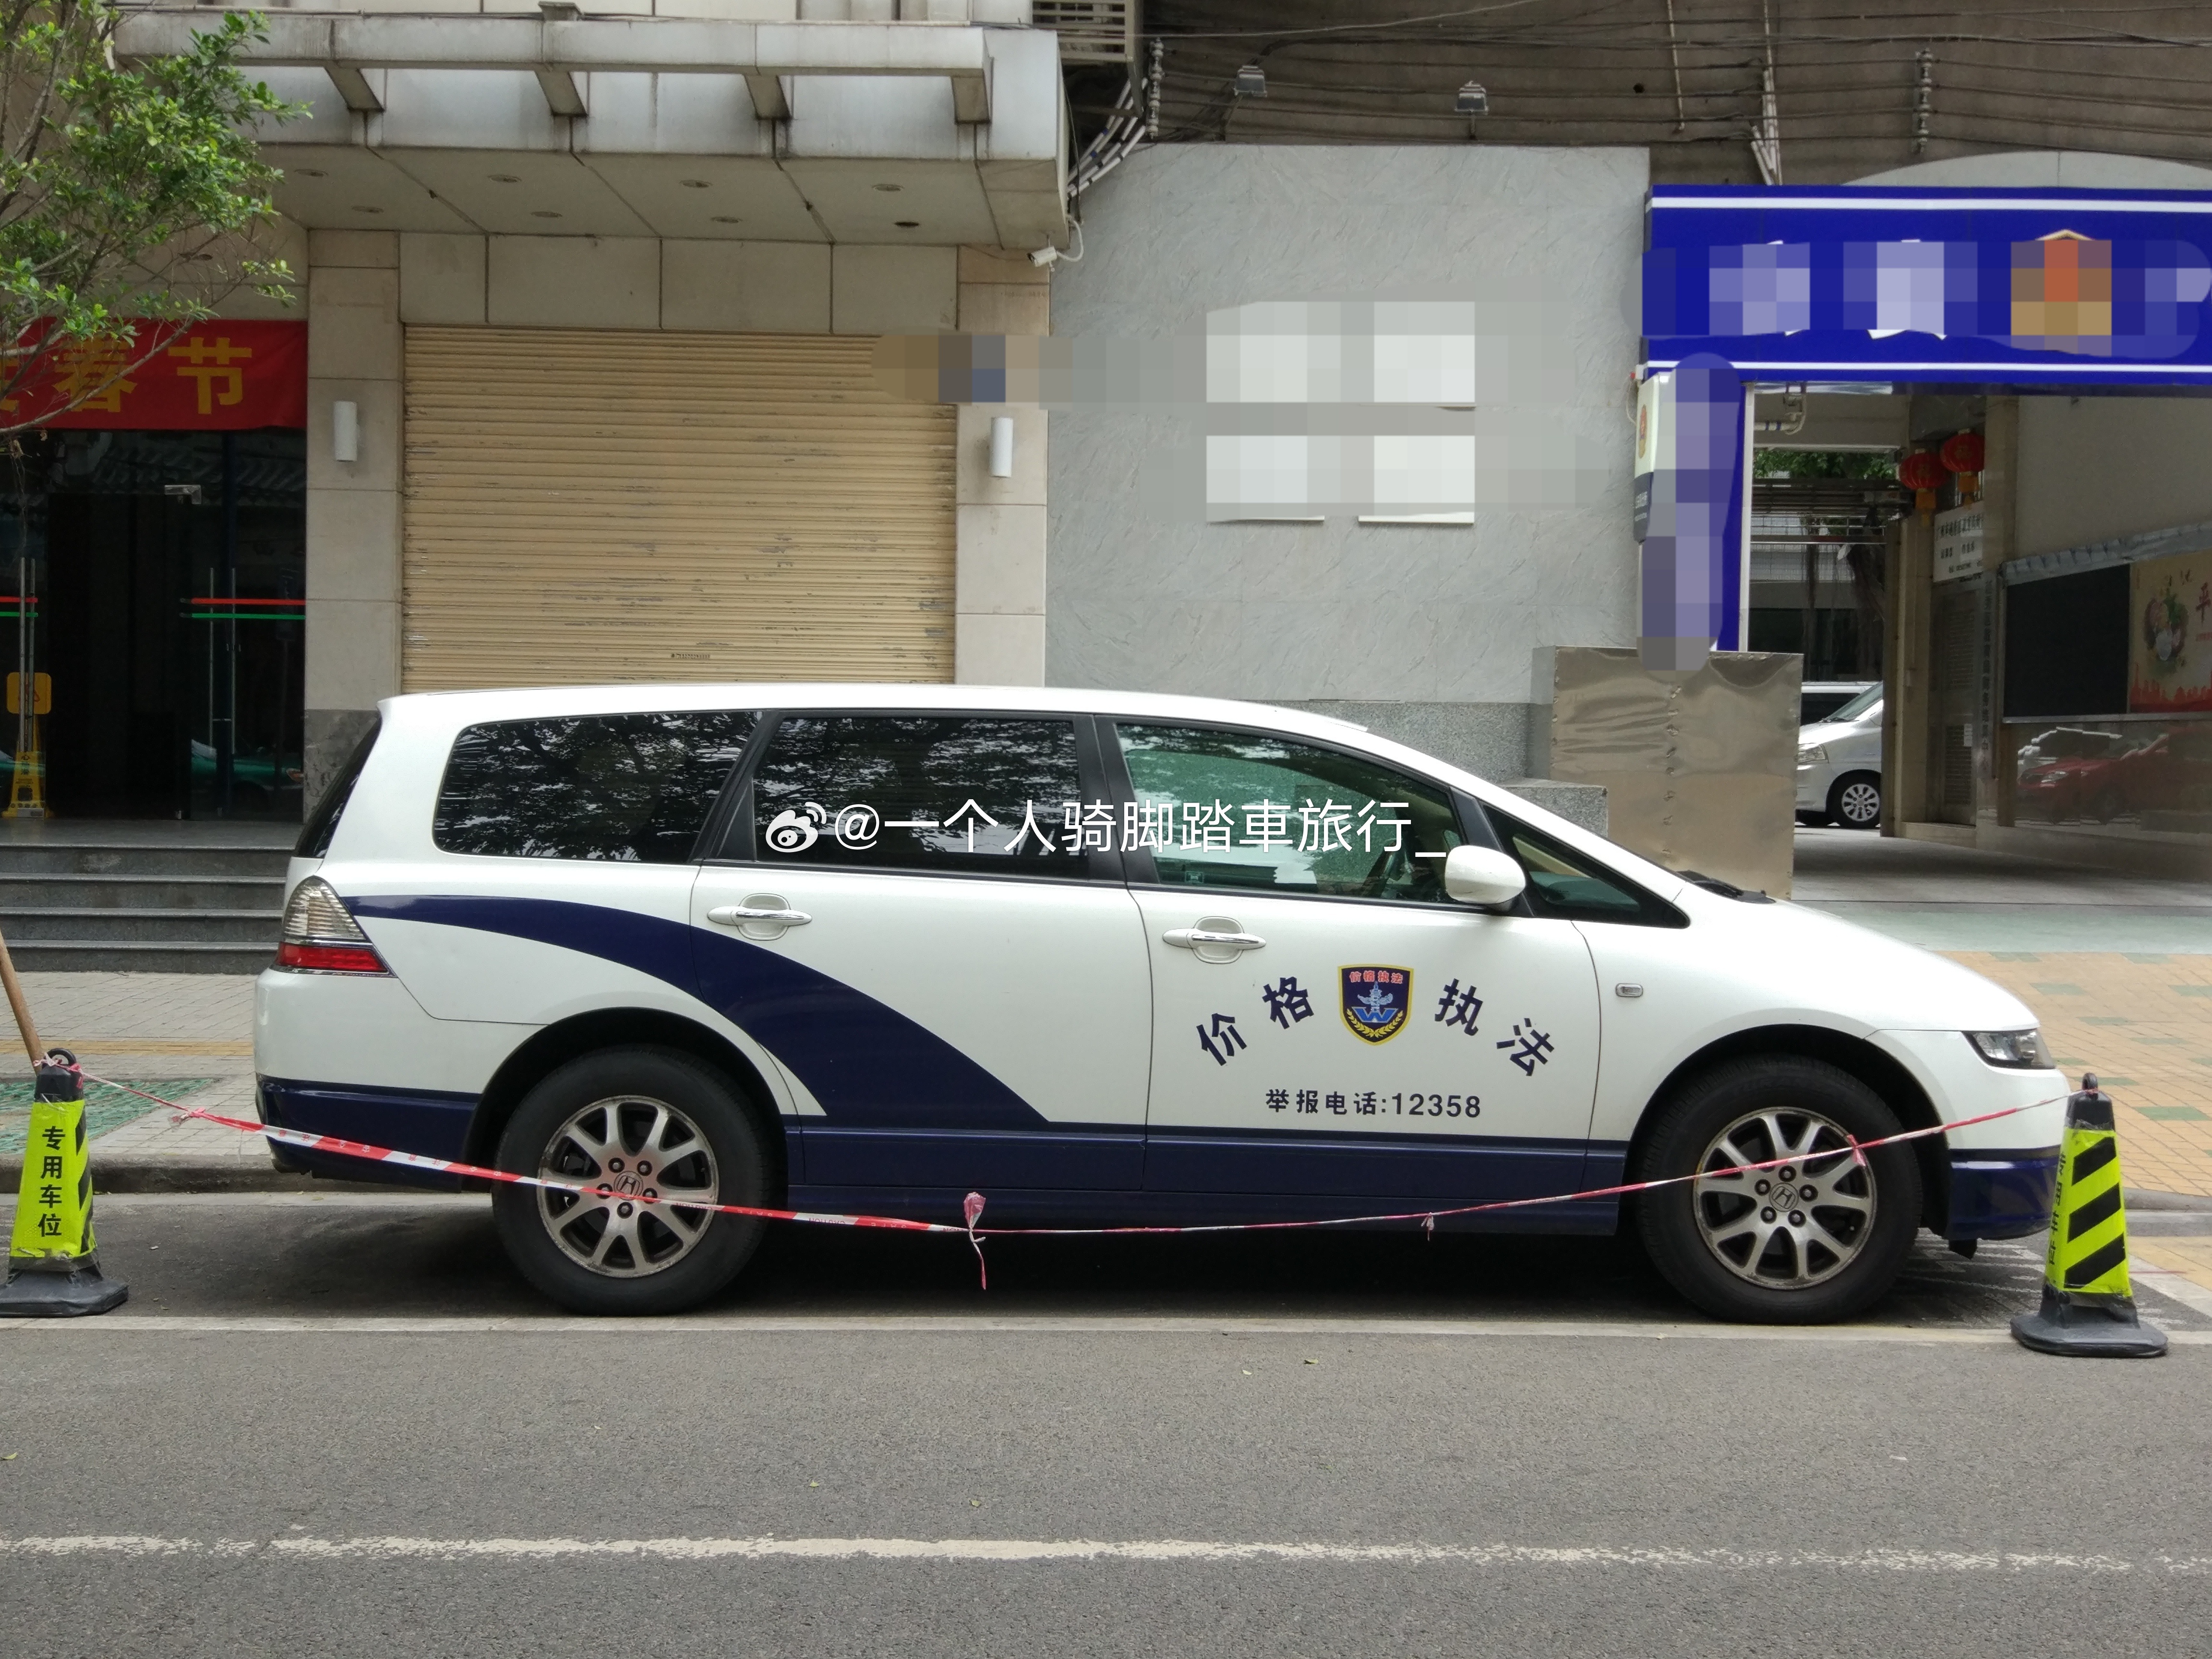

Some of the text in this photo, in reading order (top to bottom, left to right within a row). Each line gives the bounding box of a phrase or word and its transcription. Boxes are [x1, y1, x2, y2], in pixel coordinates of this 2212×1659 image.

[0, 337, 252, 414] 春节
[1196, 976, 1555, 1077] 价格 执法
[1265, 1089, 1481, 1118] 举报电话:12358
[38, 1126, 66, 1237] 专用车位
